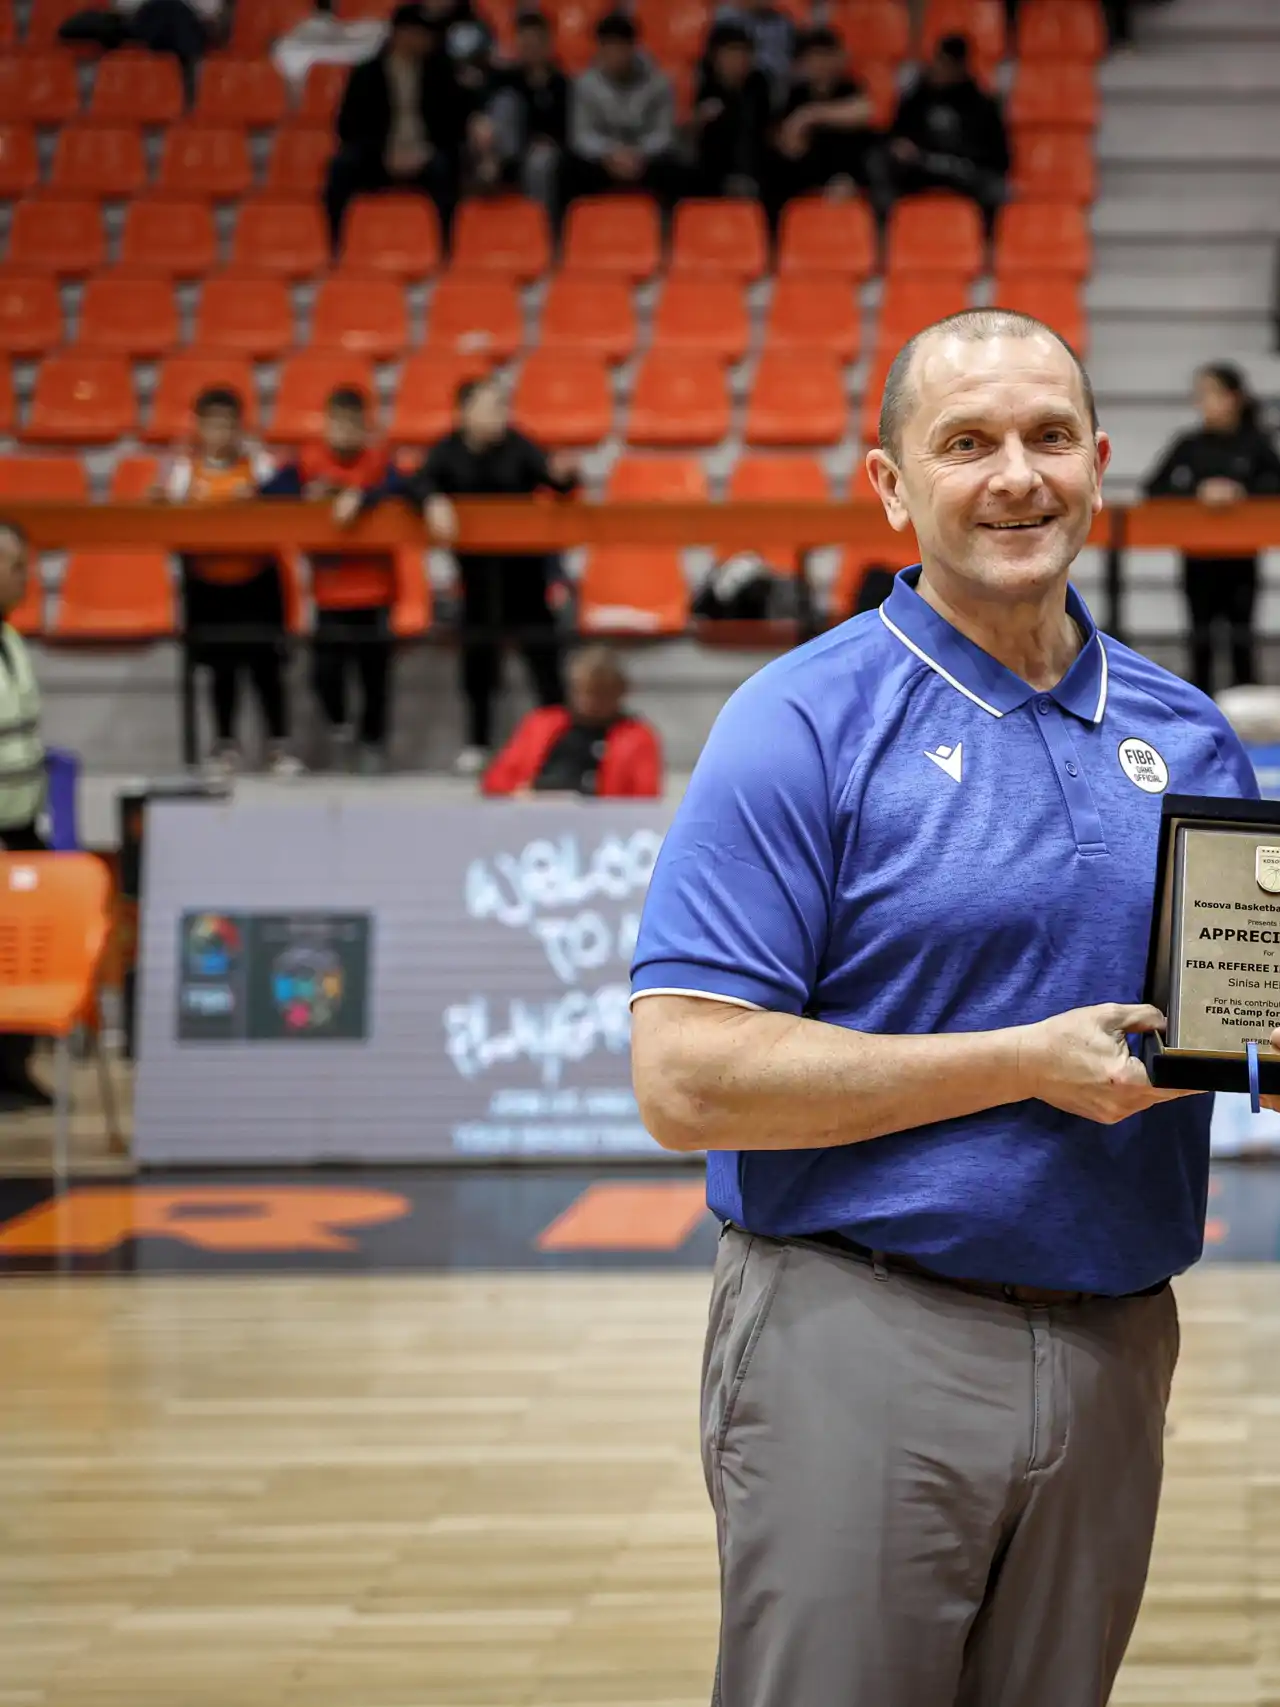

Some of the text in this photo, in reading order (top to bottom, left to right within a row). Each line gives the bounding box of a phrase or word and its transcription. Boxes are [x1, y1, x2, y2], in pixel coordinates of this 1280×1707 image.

[1124, 749, 1156, 765] FIBA
[1133, 773, 1163, 783] OFFICIAL
[1194, 900, 1231, 910] Kosova
[1247, 919, 1278, 927] Presents
[1186, 959, 1215, 970] FIBA
[1218, 961, 1270, 972] REFEREE
[1228, 978, 1260, 988] Sinisa
[1214, 997, 1228, 1005] For
[1205, 1006, 1230, 1015] FIBA
[1233, 1007, 1263, 1018] Camp
[1265, 1009, 1280, 1018] for
[1221, 1018, 1265, 1027] National
